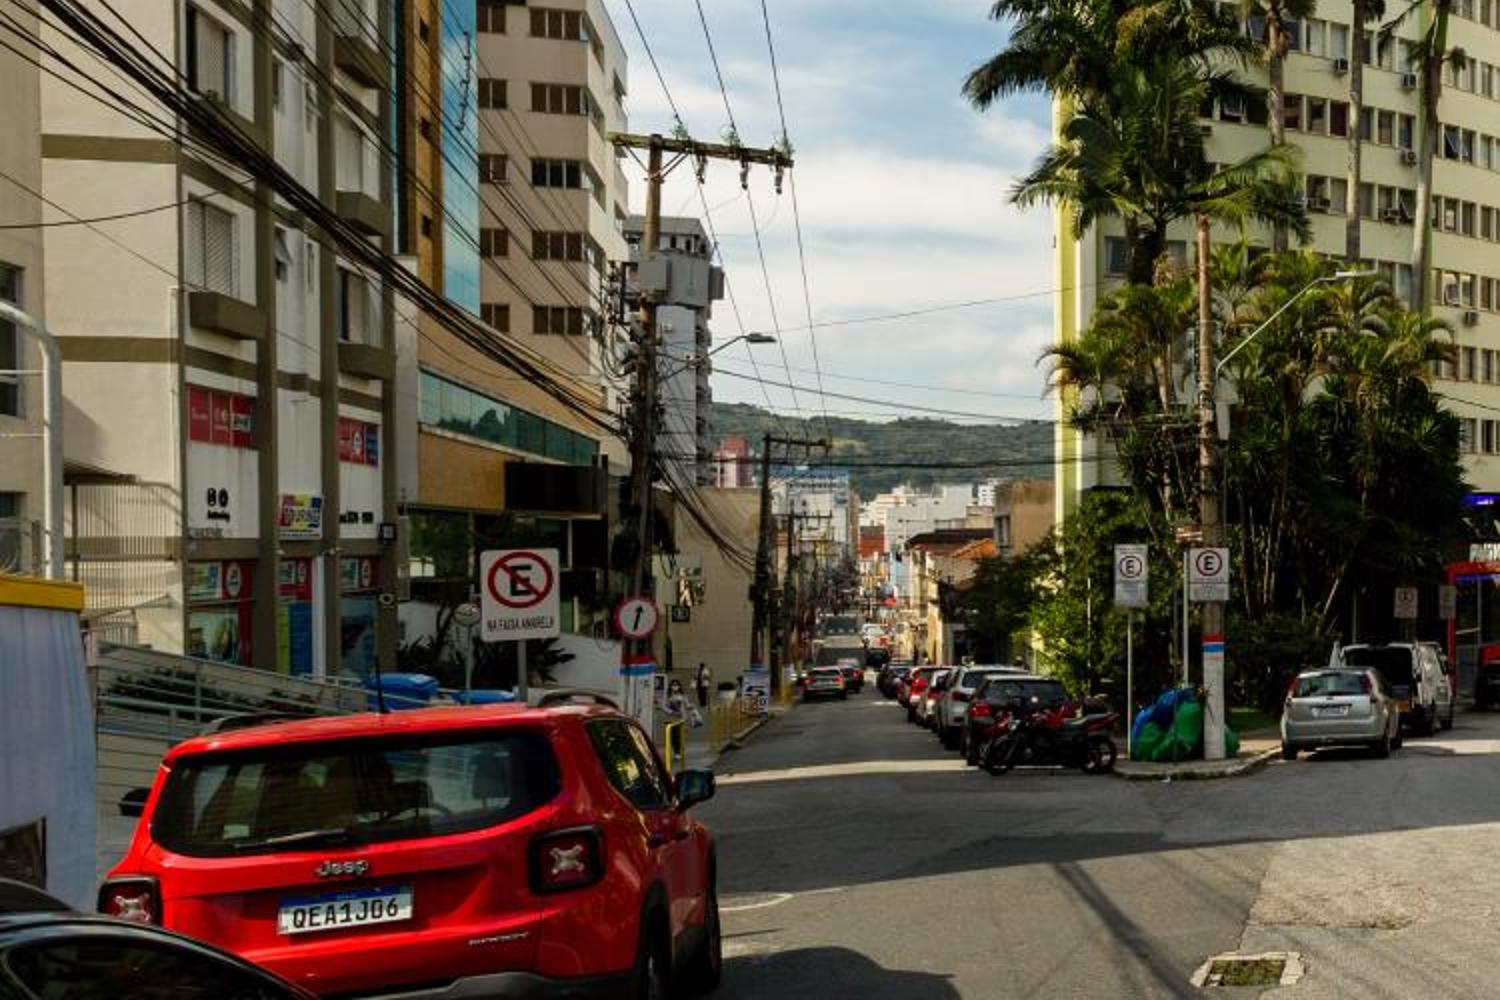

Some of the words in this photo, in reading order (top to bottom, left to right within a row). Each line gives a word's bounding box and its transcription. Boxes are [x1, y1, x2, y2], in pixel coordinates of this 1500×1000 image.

[1126, 560, 1135, 575] E
[1204, 556, 1215, 571] E
[510, 565, 532, 596] E
[318, 861, 368, 876] Jeep
